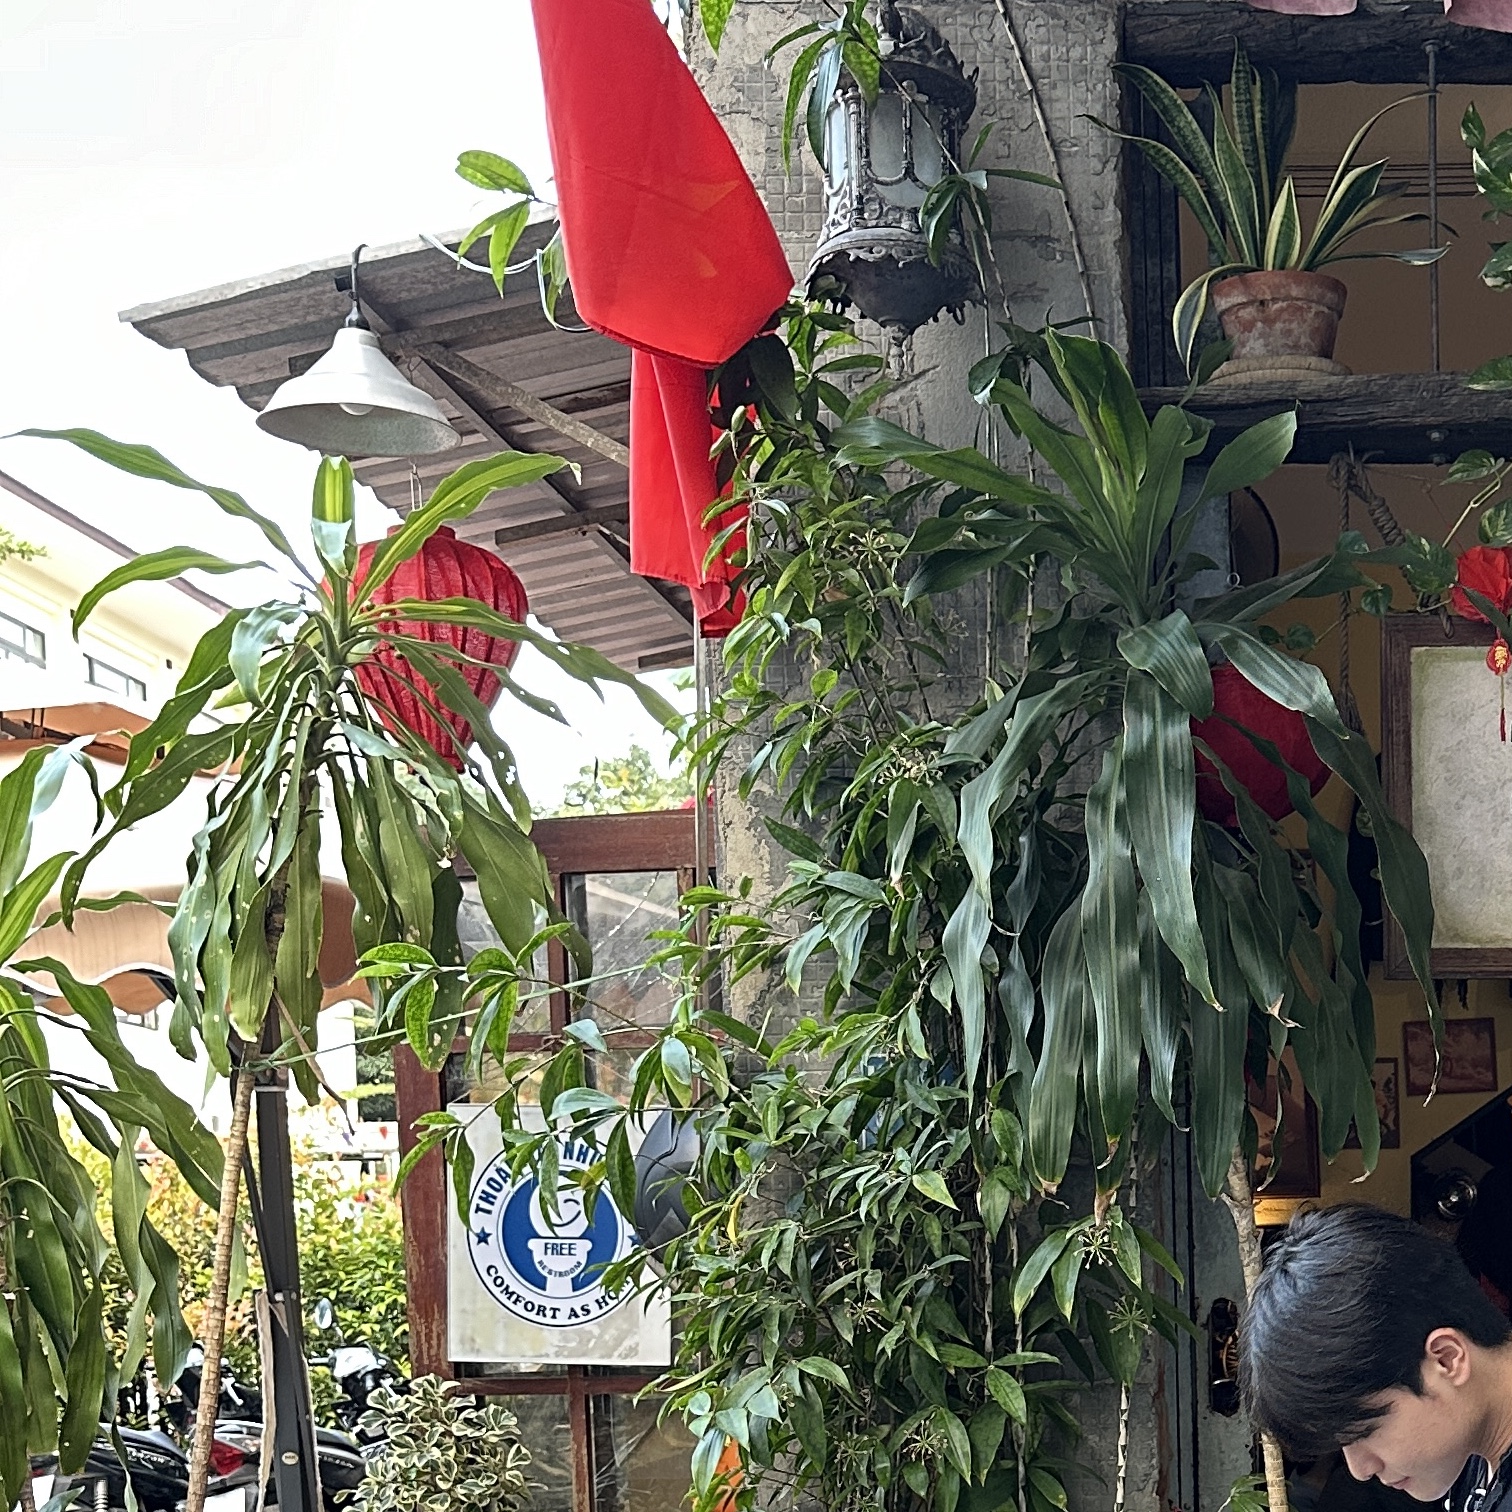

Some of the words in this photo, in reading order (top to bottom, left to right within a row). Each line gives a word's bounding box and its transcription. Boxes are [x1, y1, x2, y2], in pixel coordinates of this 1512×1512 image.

[544, 1242, 577, 1256] FREE
[537, 1259, 583, 1279] RESTROOM
[486, 1264, 560, 1319] COMFORT
[568, 1304, 591, 1320] AS
[597, 1277, 633, 1311] HO
